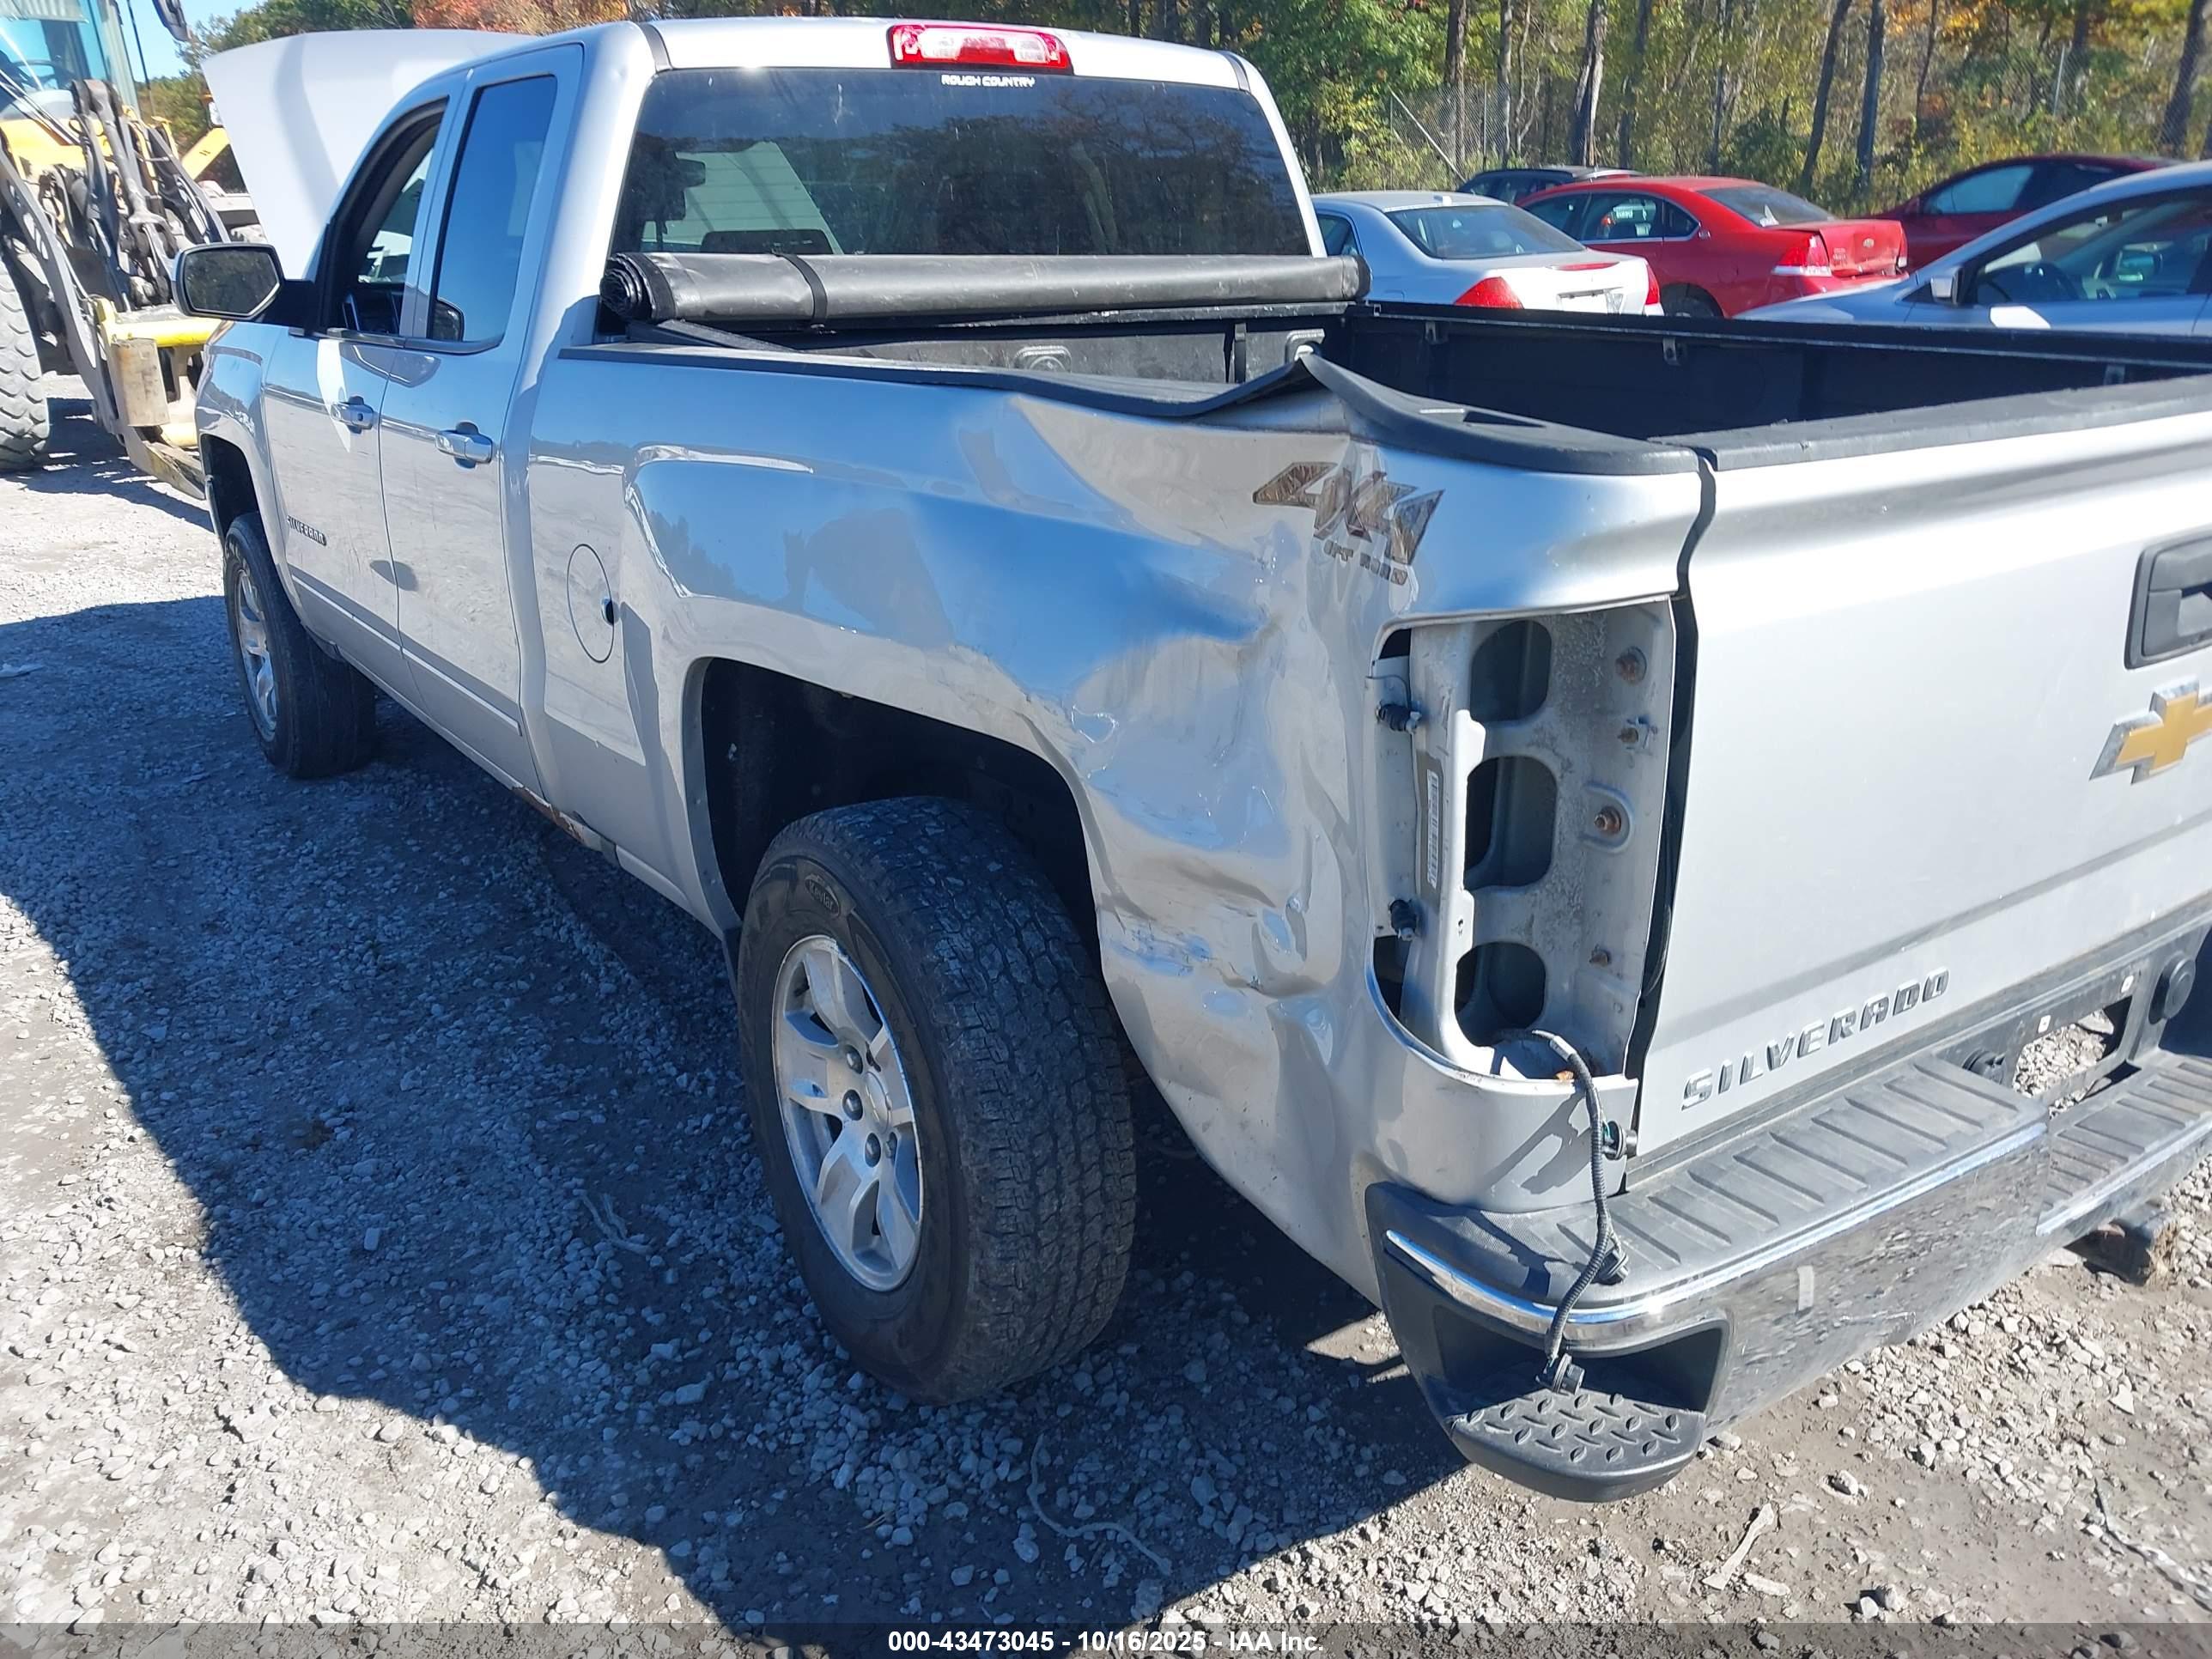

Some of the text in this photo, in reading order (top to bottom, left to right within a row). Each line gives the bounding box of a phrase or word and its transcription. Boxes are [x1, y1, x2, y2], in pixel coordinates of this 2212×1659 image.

[941, 74, 1036, 88] ROUGH COUNTRY
[1360, 552, 1408, 586] ROAD
[808, 879, 835, 912] Kevlar
[1680, 966, 1949, 1111] SILVERADO
